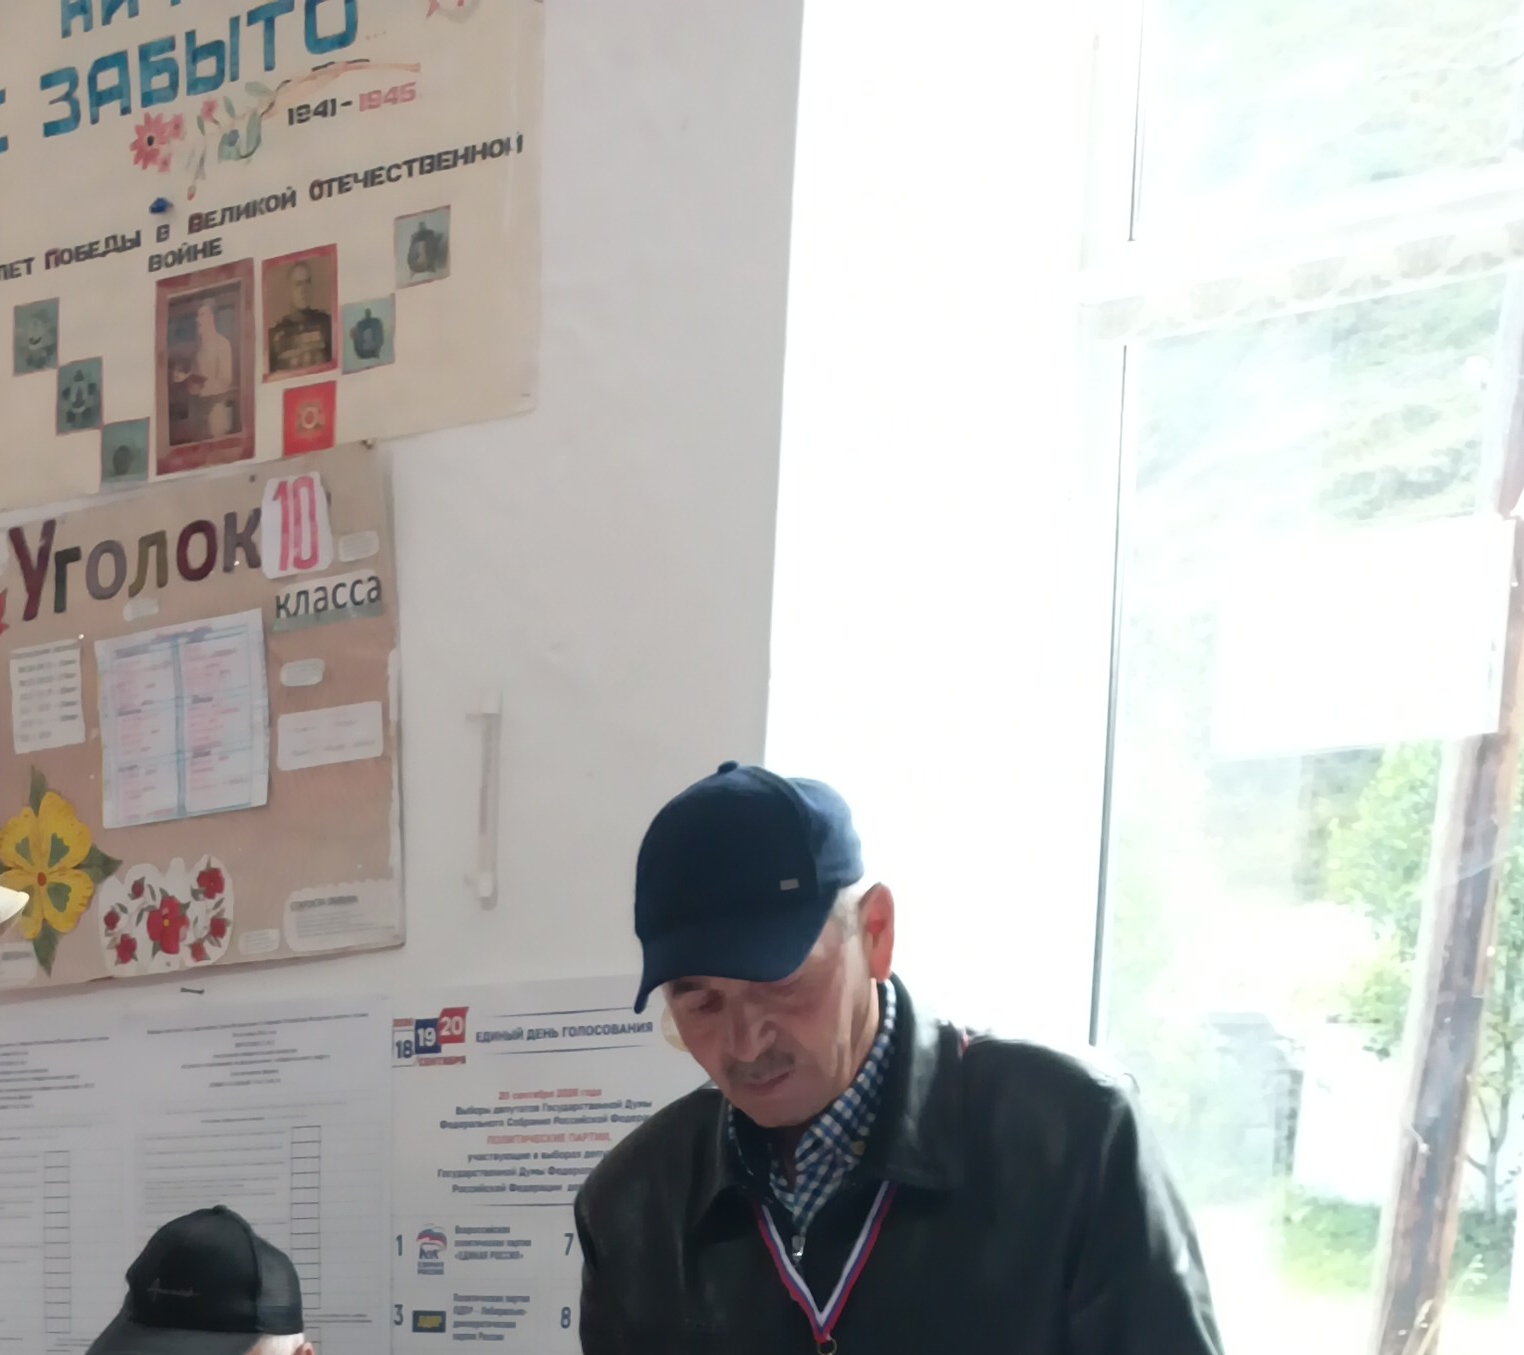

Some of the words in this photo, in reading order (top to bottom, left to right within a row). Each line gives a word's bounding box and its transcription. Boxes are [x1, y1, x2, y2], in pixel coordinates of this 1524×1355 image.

[40, 0, 359, 138] ЗАБЫТО
[44, 230, 142, 271] ПОБЕДЫ
[156, 224, 171, 244] В
[188, 186, 297, 235] ВЕЛИКОЙ
[309, 131, 524, 201] ОТЕЧЕСТВЕННОЙ
[148, 237, 223, 272] ВОЙНЕ
[9, 507, 263, 622] Уголок
[272, 475, 320, 571] 10
[275, 573, 383, 619] класса
[418, 1027, 436, 1047] 19
[439, 1016, 464, 1036] 20
[476, 1027, 524, 1043] ЕДИНЫЙ
[526, 1024, 559, 1041] ДЕНЬ
[562, 1022, 653, 1038] ГОЛОСОВАНИЯ
[396, 1039, 413, 1059] 18
[396, 1234, 403, 1257] 1
[564, 1233, 574, 1256] 7
[393, 1304, 404, 1326] 3
[560, 1306, 572, 1329] 8
